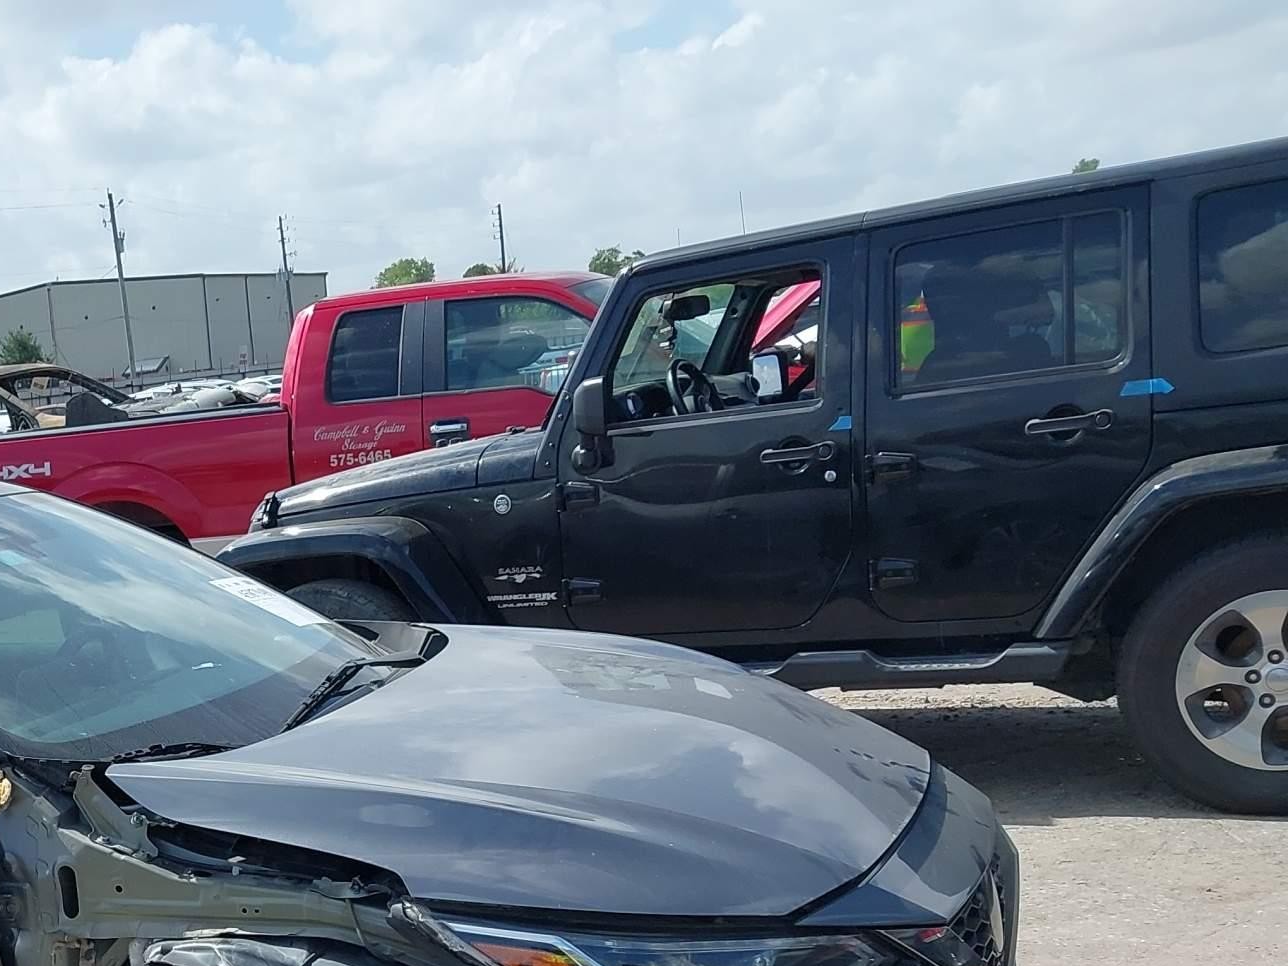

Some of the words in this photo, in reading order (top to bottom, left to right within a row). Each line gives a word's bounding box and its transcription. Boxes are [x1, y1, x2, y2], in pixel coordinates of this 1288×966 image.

[314, 424, 360, 441] Campbell
[342, 438, 377, 450] Storage
[329, 448, 392, 467] 575-6465
[498, 566, 543, 575] SAHARA
[497, 601, 549, 609] UNLIMITED
